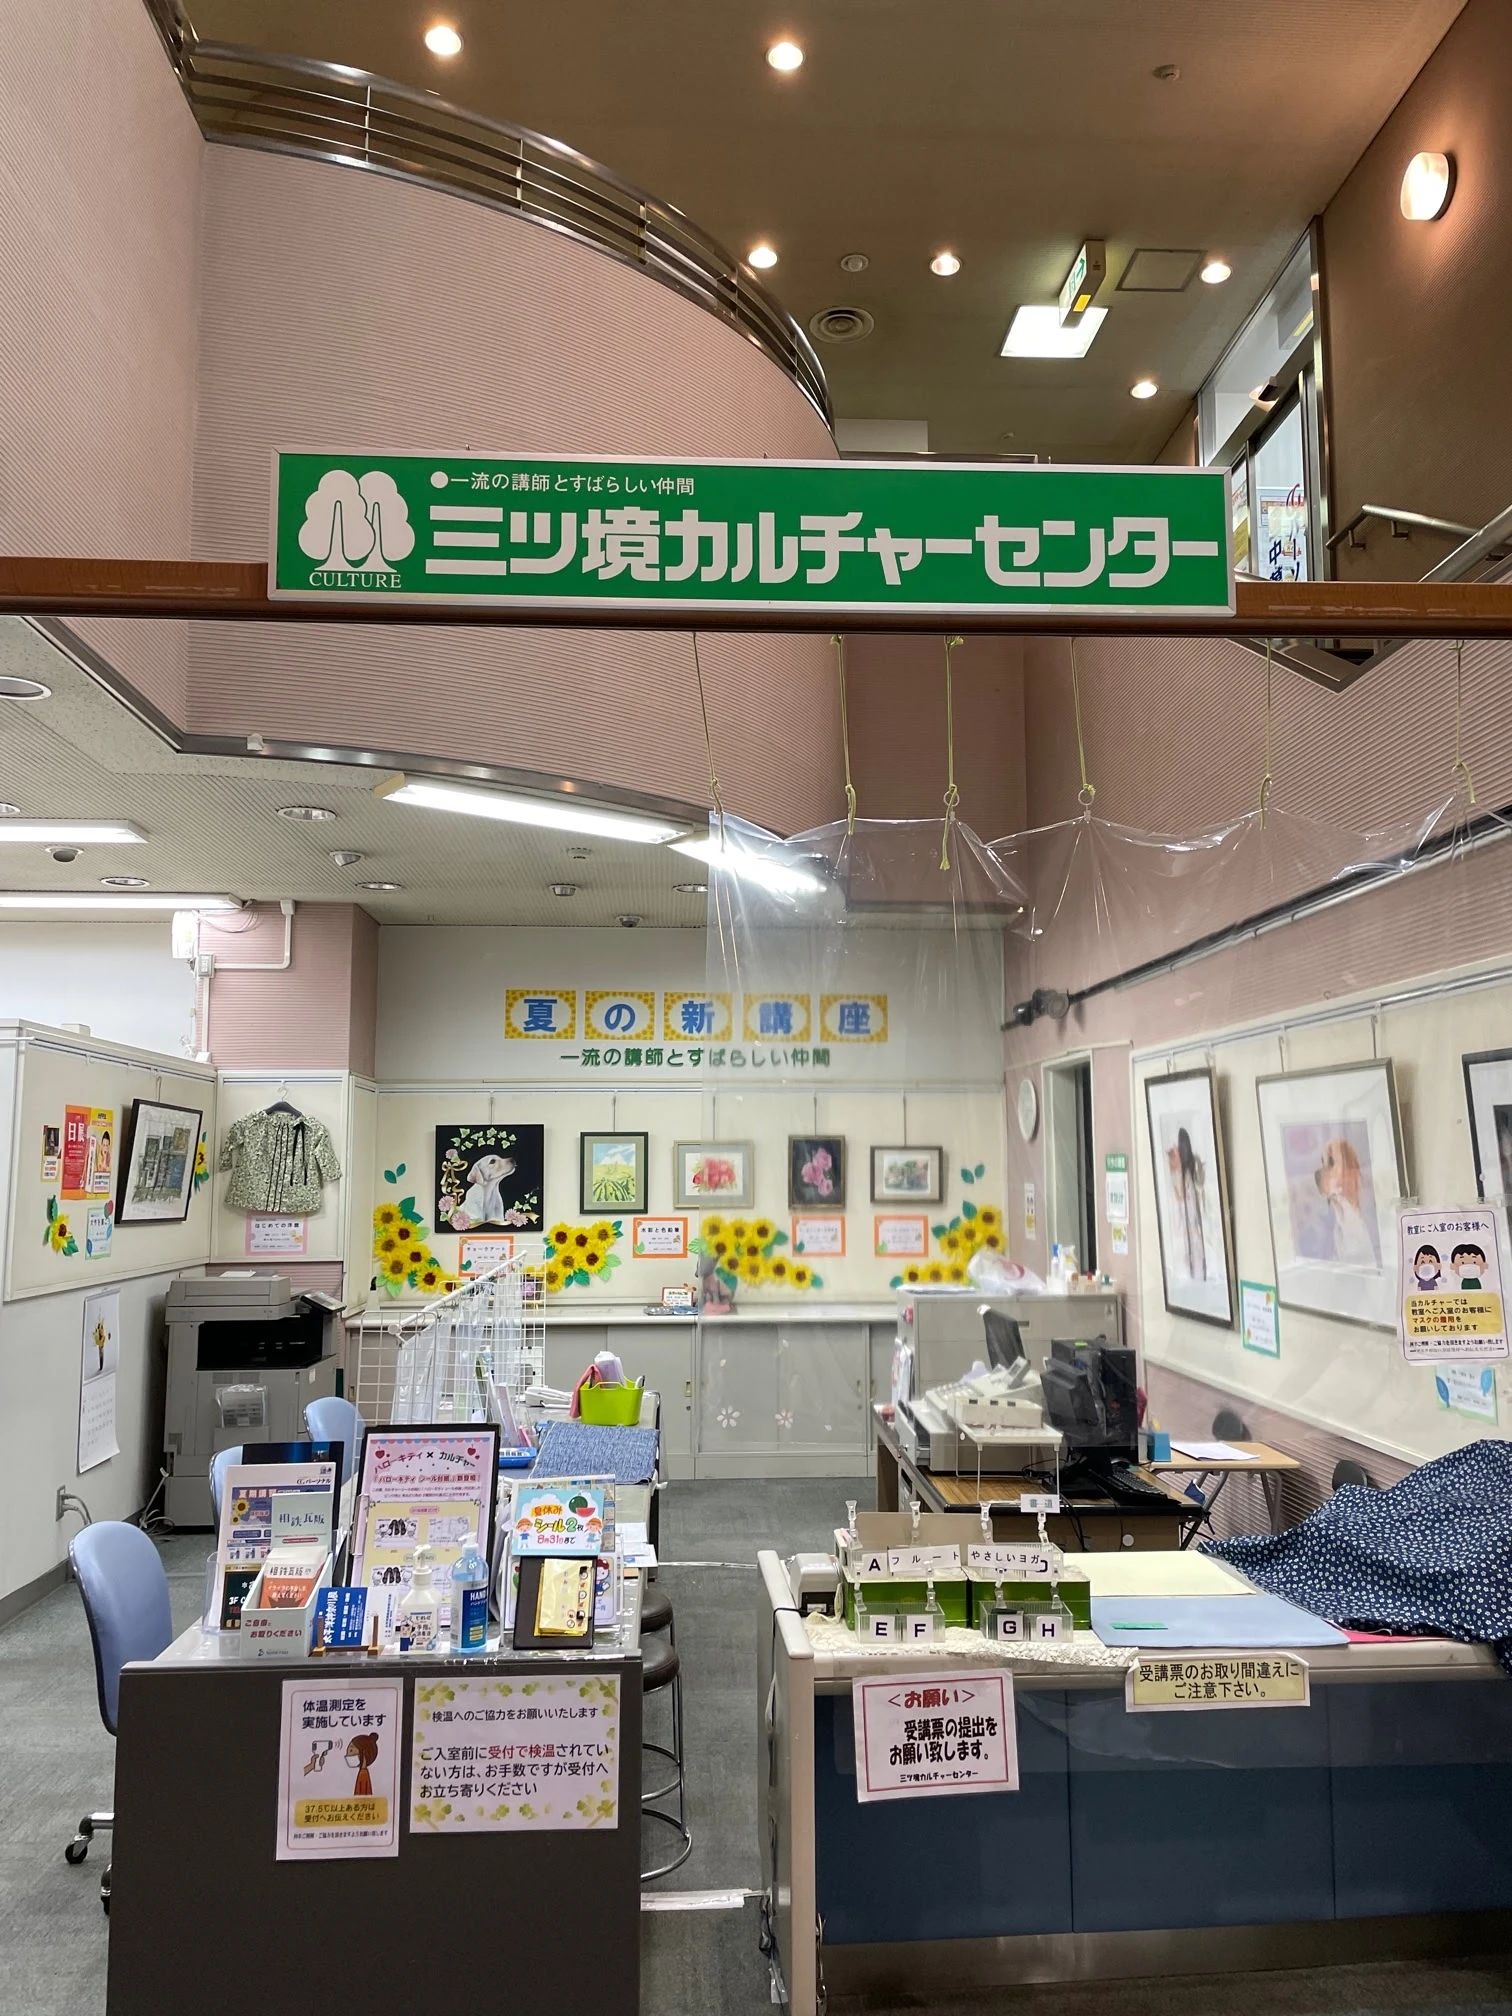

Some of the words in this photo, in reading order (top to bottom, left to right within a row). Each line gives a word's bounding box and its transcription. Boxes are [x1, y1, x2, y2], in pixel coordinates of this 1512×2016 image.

[450, 472, 695, 496] 一流の講師とすばらしい仲間
[425, 505, 1219, 589] 三ツ境カルチャーセンター
[309, 572, 402, 588] CULTURE
[523, 999, 872, 1035] 夏の新講座
[560, 1048, 831, 1068] 一流の講師とすばらしい仲間
[1407, 1221, 1490, 1235] 教室にご入室のお客様へ
[1414, 1324, 1478, 1333] お願いしております
[868, 1558, 881, 1572] A
[971, 1551, 1040, 1565] やさしいヨガ
[250, 1630, 302, 1639] お取りください
[875, 1621, 888, 1636] E
[914, 1623, 926, 1638] F
[1002, 1620, 1017, 1635] G
[1041, 1623, 1055, 1638] H
[1139, 1661, 1300, 1682] 受講票のお取り間違えに
[1174, 1681, 1266, 1699] ご注意下さい。
[302, 1698, 366, 1713] 体温測定を
[302, 1713, 387, 1729] 実施しています
[432, 1707, 599, 1723] 検温へのご協力をお願いいたします
[904, 1715, 998, 1742] 受講票の提出を
[420, 1743, 609, 1761] ご入室前に受付で検温されてい
[889, 1739, 989, 1766] お願い致します。
[420, 1762, 609, 1780] ない方は、お手数ですが受付へ
[899, 1770, 979, 1783] 三ツ境カルチャーセンター
[419, 1782, 538, 1799] お立ち寄りください
[304, 1812, 380, 1823] 受付へお伝えください
